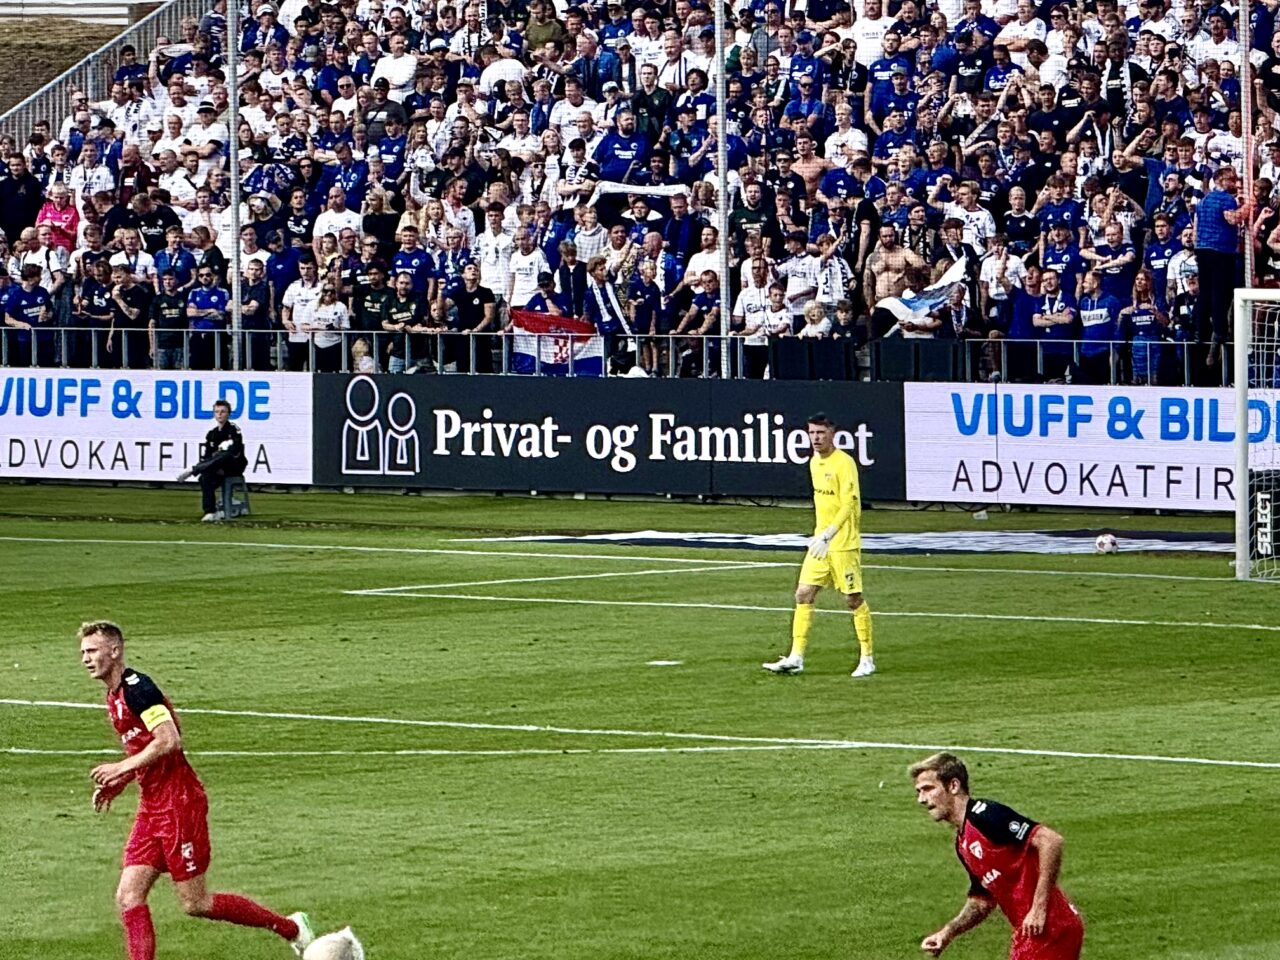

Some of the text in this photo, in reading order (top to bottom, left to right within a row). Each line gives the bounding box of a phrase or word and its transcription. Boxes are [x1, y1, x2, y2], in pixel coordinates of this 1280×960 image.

[111, 379, 143, 419] &
[155, 380, 271, 421] BILDE
[950, 392, 1094, 438] VIUFF
[1107, 396, 1145, 440] &
[0, 438, 272, 473] DVOKATFIA
[433, 408, 876, 473] Privat- og Familieet
[952, 458, 1236, 503] ADVOKATFIR
[1257, 491, 1272, 556] SELECT
